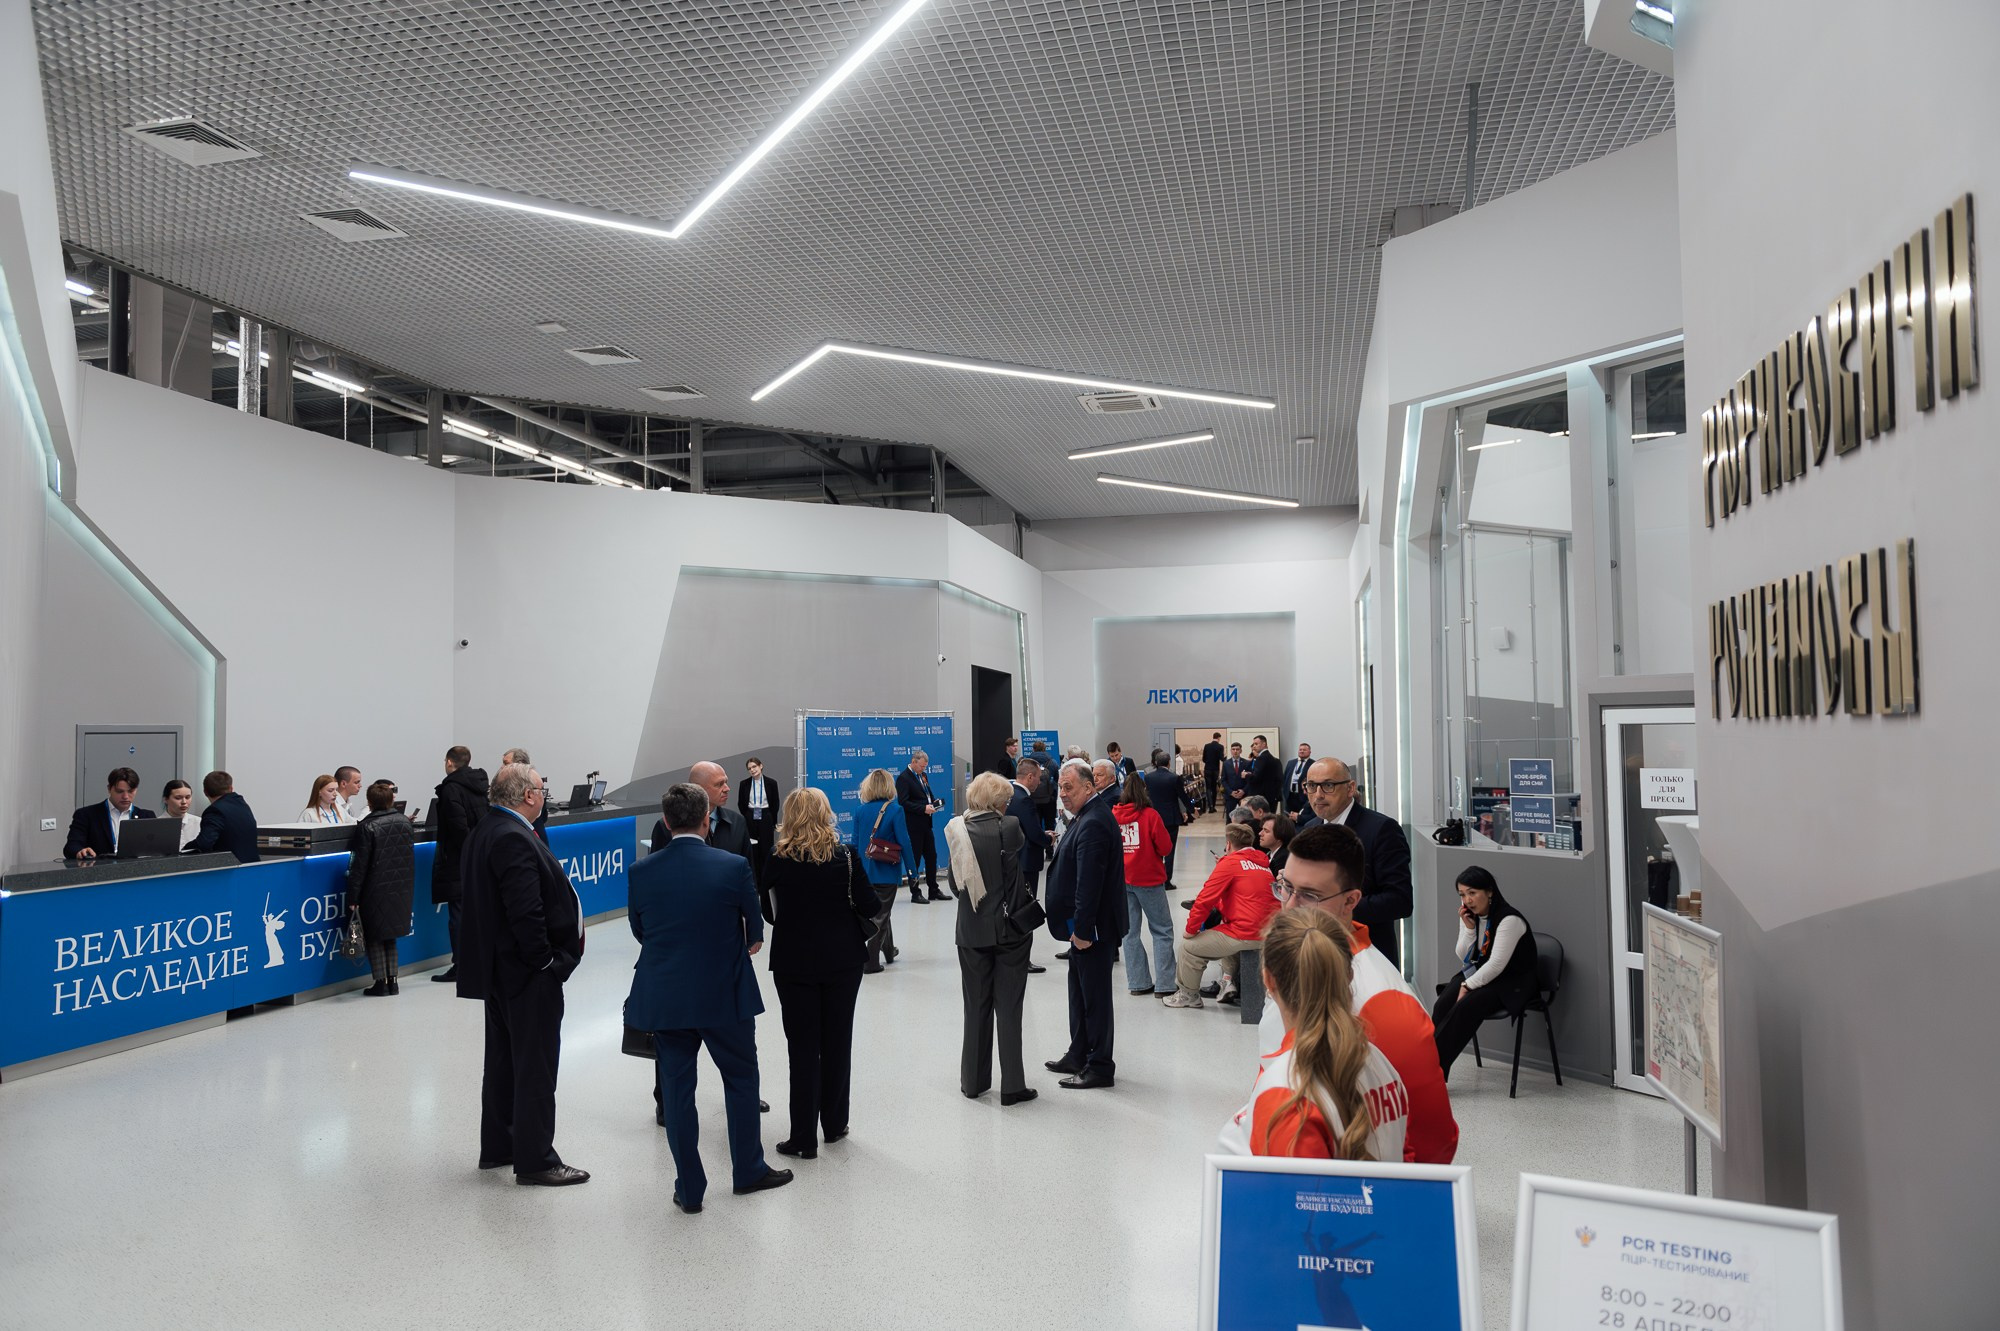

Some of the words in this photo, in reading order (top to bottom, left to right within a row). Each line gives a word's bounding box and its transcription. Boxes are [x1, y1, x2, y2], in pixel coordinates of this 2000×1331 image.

[1146, 684, 1238, 704] ЛЕКТОРИЙ
[1650, 795, 1685, 803] ПРЕССЫ
[558, 848, 623, 885] ТАЦИЯ
[53, 910, 233, 972] ВЕЛИКОЕ
[52, 945, 249, 1016] НАСЛЕДИЕ
[1295, 1202, 1329, 1212] ОБЩЕЕ
[1330, 1203, 1374, 1215] БУДУЩЕЕ
[1297, 1254, 1375, 1274] ПЦР-ТЕСТ
[1622, 1235, 1655, 1252] PCR
[1660, 1241, 1732, 1265] TESTING
[1621, 1252, 1750, 1283] ПЦР-ТЕСТИРОВАНИЕ
[1599, 1308, 1625, 1328] 28
[1601, 1285, 1647, 1308] 8:00
[1671, 1297, 1732, 1323] 22:00
